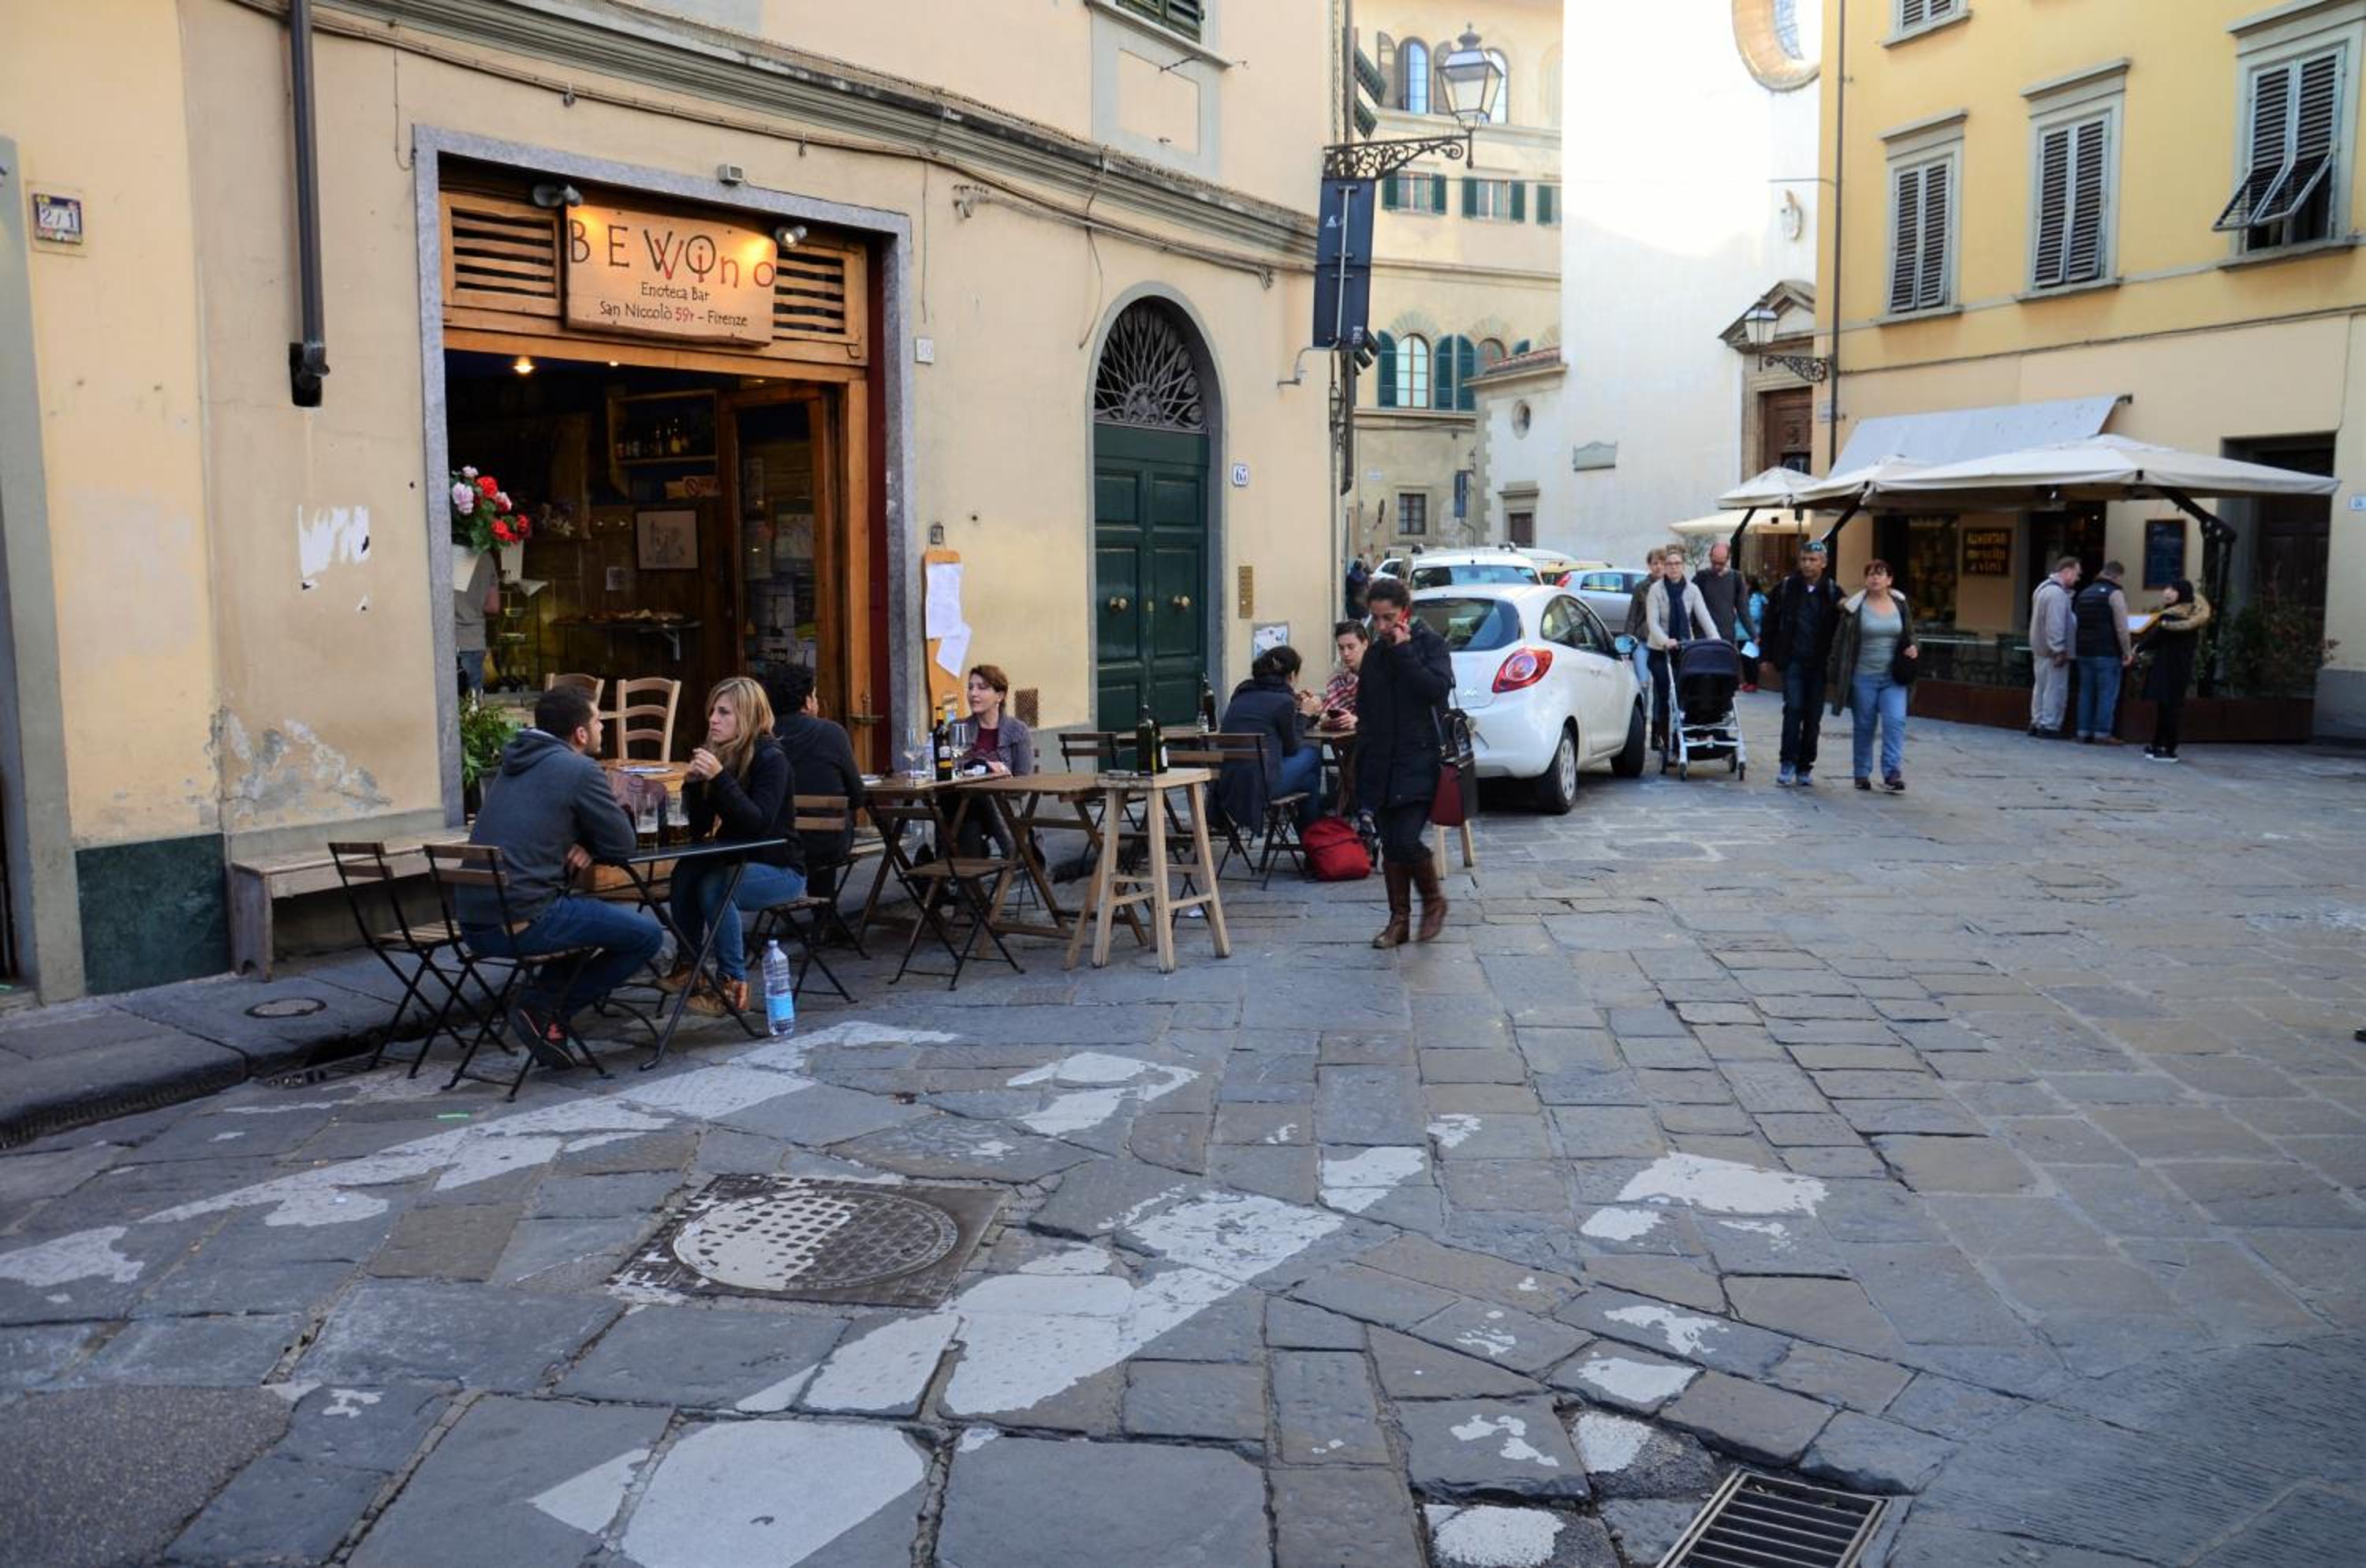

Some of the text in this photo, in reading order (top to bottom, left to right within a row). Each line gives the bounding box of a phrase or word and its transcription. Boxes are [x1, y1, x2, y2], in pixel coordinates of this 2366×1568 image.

[640, 281, 710, 301] Enoteca Bar
[599, 301, 621, 316] San
[625, 302, 673, 320] Niccolò
[675, 309, 695, 323] 59r
[707, 310, 748, 327] Firenze
